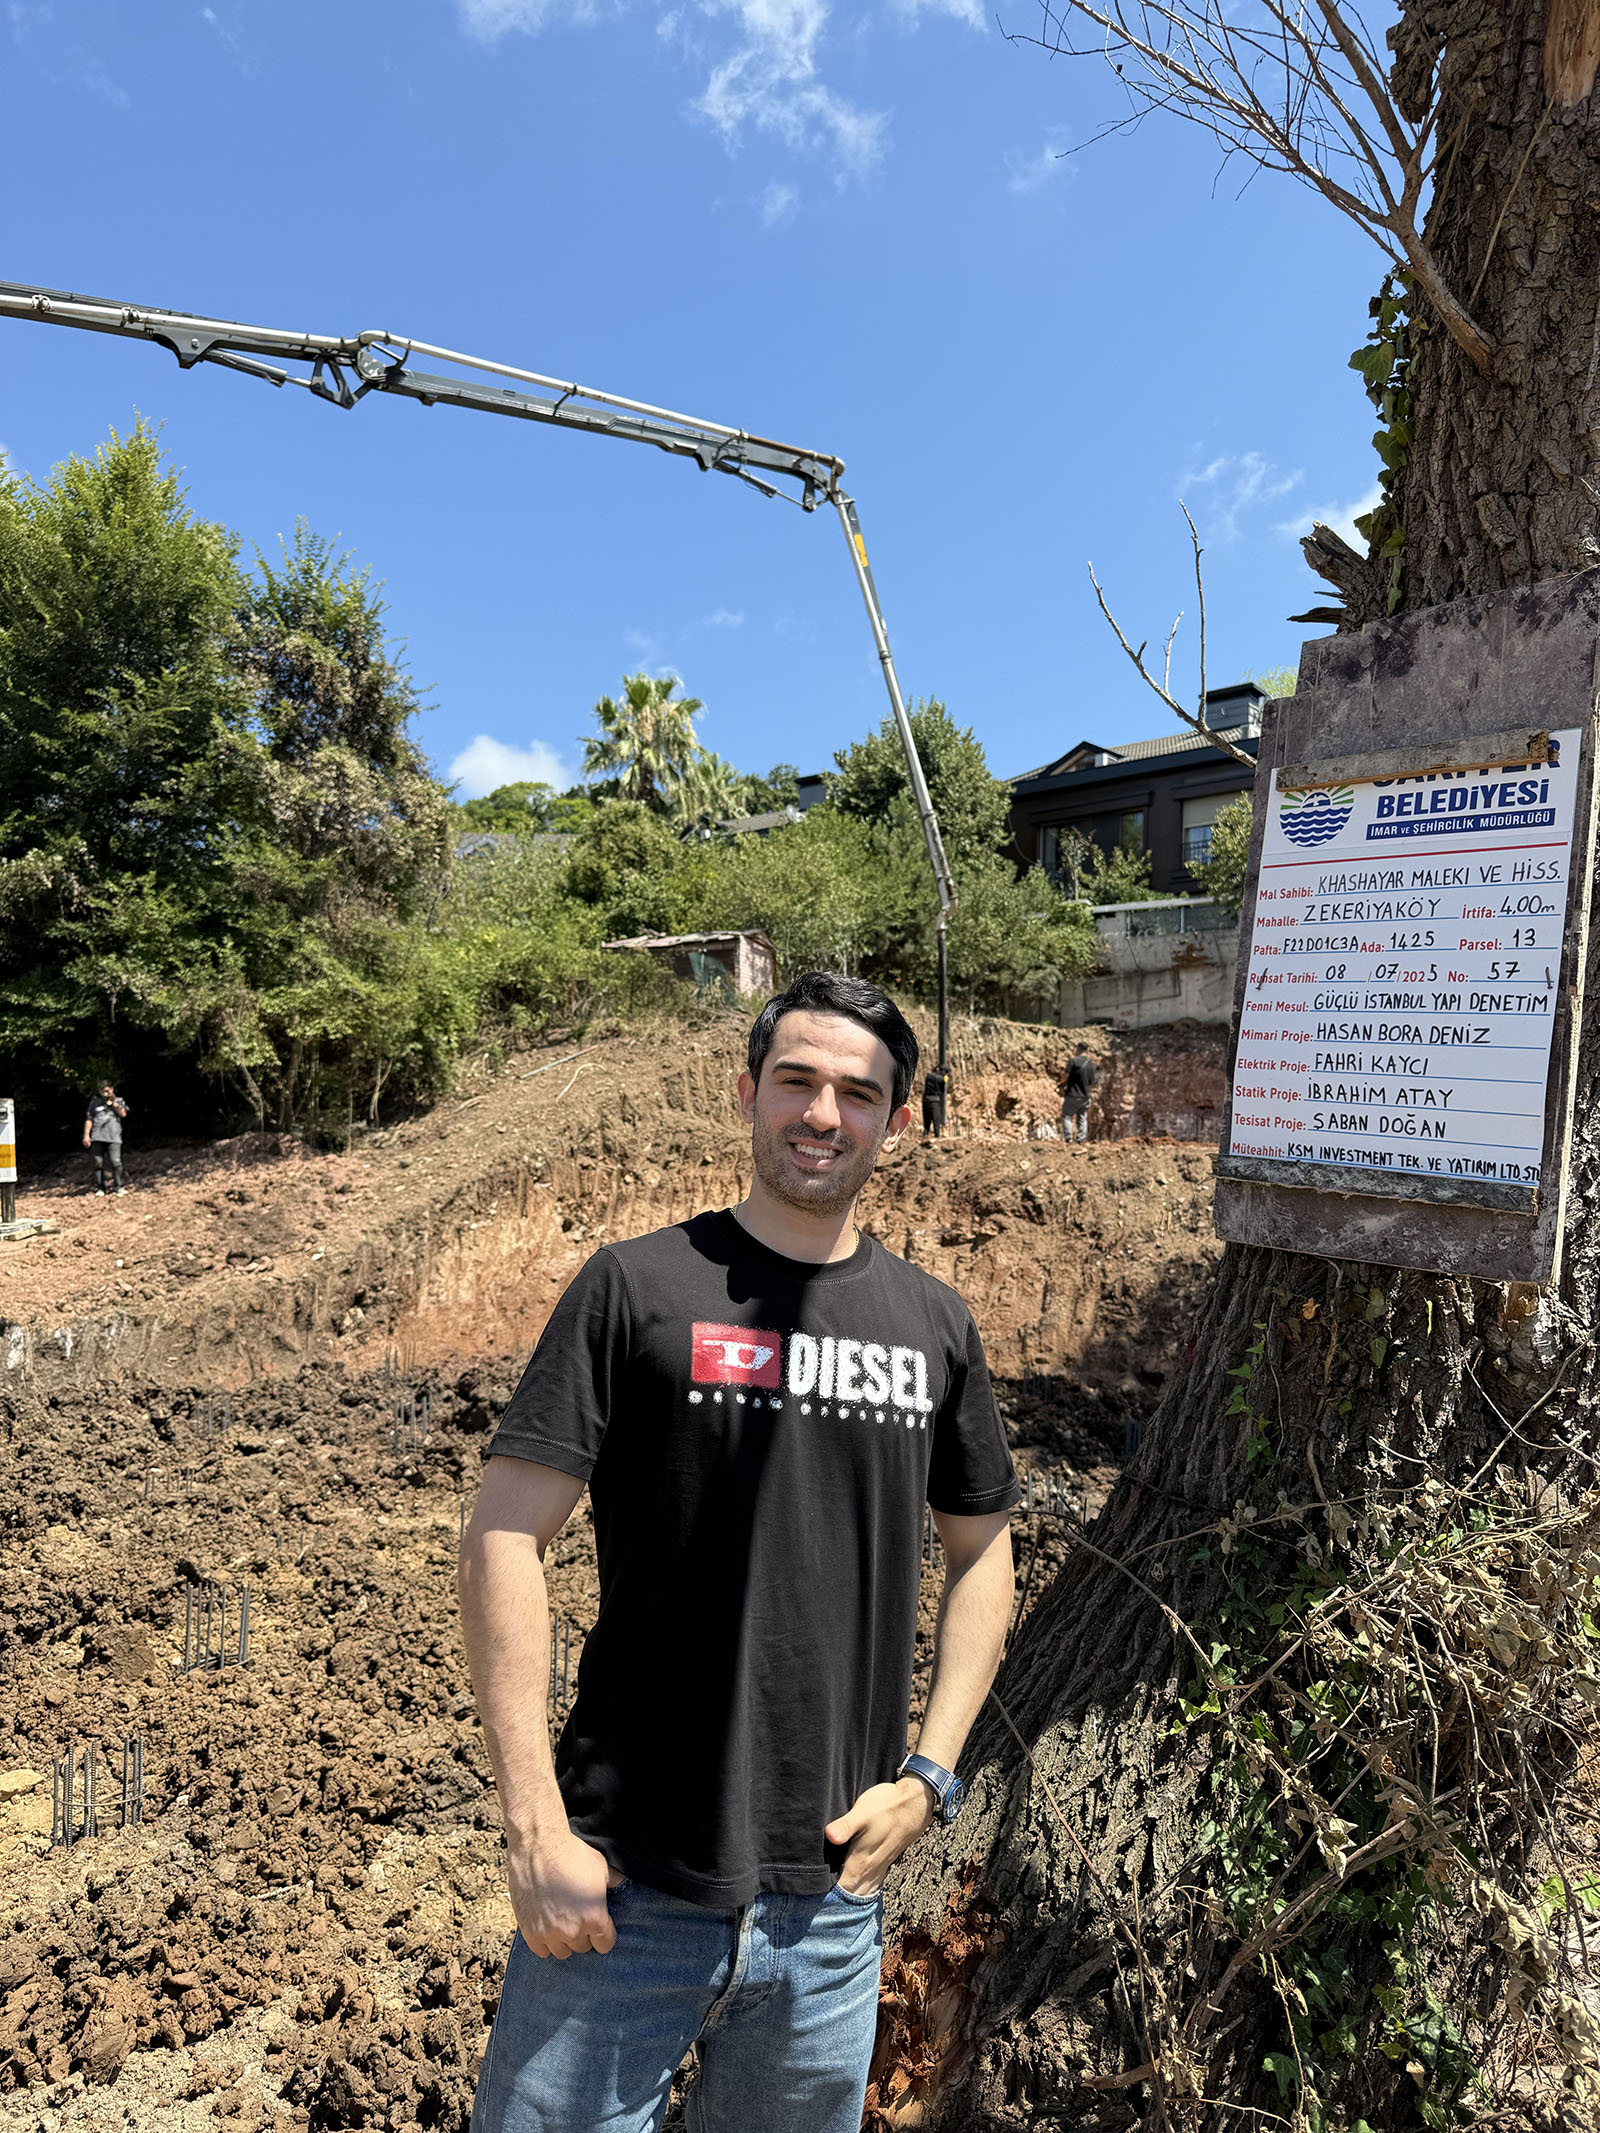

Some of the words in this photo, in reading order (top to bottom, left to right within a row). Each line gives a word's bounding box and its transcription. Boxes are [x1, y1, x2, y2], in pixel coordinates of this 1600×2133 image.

[1370, 824, 1398, 837] İMAR
[1413, 818, 1475, 836] ŞEHİRCİLİK
[1479, 810, 1551, 828] MÜDÜRLÜĞÜ
[1259, 890, 1277, 900] Mal
[1280, 887, 1313, 899] Sahibi:
[1318, 870, 1404, 893] KHASHAYAR
[1411, 867, 1470, 887] MALEKI
[1479, 865, 1502, 883] VE
[1256, 916, 1298, 927] Mahalle:
[1462, 904, 1496, 919] İrtifa:
[1253, 945, 1281, 955] Pafta:
[1360, 942, 1385, 953] Ada:
[1390, 930, 1435, 949] 1425
[1459, 938, 1502, 951] Parsel:
[1513, 928, 1536, 947] 13
[1287, 972, 1317, 984] Tarihi:
[1325, 964, 1346, 980] 08
[1448, 971, 1469, 983] No:
[1487, 961, 1521, 980] 57
[1245, 1001, 1272, 1012] Fenni
[1275, 1001, 1309, 1013] Mesul:
[1314, 990, 1359, 1011] GÜÇLÜ
[1364, 990, 1427, 1010] İSTANBUL
[1431, 992, 1461, 1011] YAPI
[1241, 1029, 1277, 1041] Mimari
[1281, 1030, 1314, 1044] Proje:
[1317, 1022, 1373, 1041] HASAN
[1378, 1023, 1423, 1043] BORA
[1237, 1058, 1276, 1071] Elektrik
[1280, 1060, 1310, 1074] Proje:
[1371, 1055, 1429, 1076] KAYCI
[1235, 1085, 1266, 1098] Statik
[1270, 1087, 1302, 1103] Proje:
[1308, 1077, 1386, 1104] İBRAHİM
[1395, 1087, 1453, 1108] ATAY
[1234, 1113, 1271, 1127] Tesisat
[1274, 1116, 1307, 1132] Proje:
[1313, 1112, 1368, 1131] ŞABAN
[1379, 1113, 1446, 1138] DOĞAN
[1232, 1143, 1285, 1158] Müteahhit:
[1287, 1142, 1313, 1159] KSM
[1319, 1146, 1394, 1166] INVESTMENT
[1397, 1153, 1424, 1168] TEK.
[1427, 1157, 1442, 1171] VE
[1446, 1157, 1497, 1178] YATIRIM
[788, 1331, 934, 1414] DIESEL
